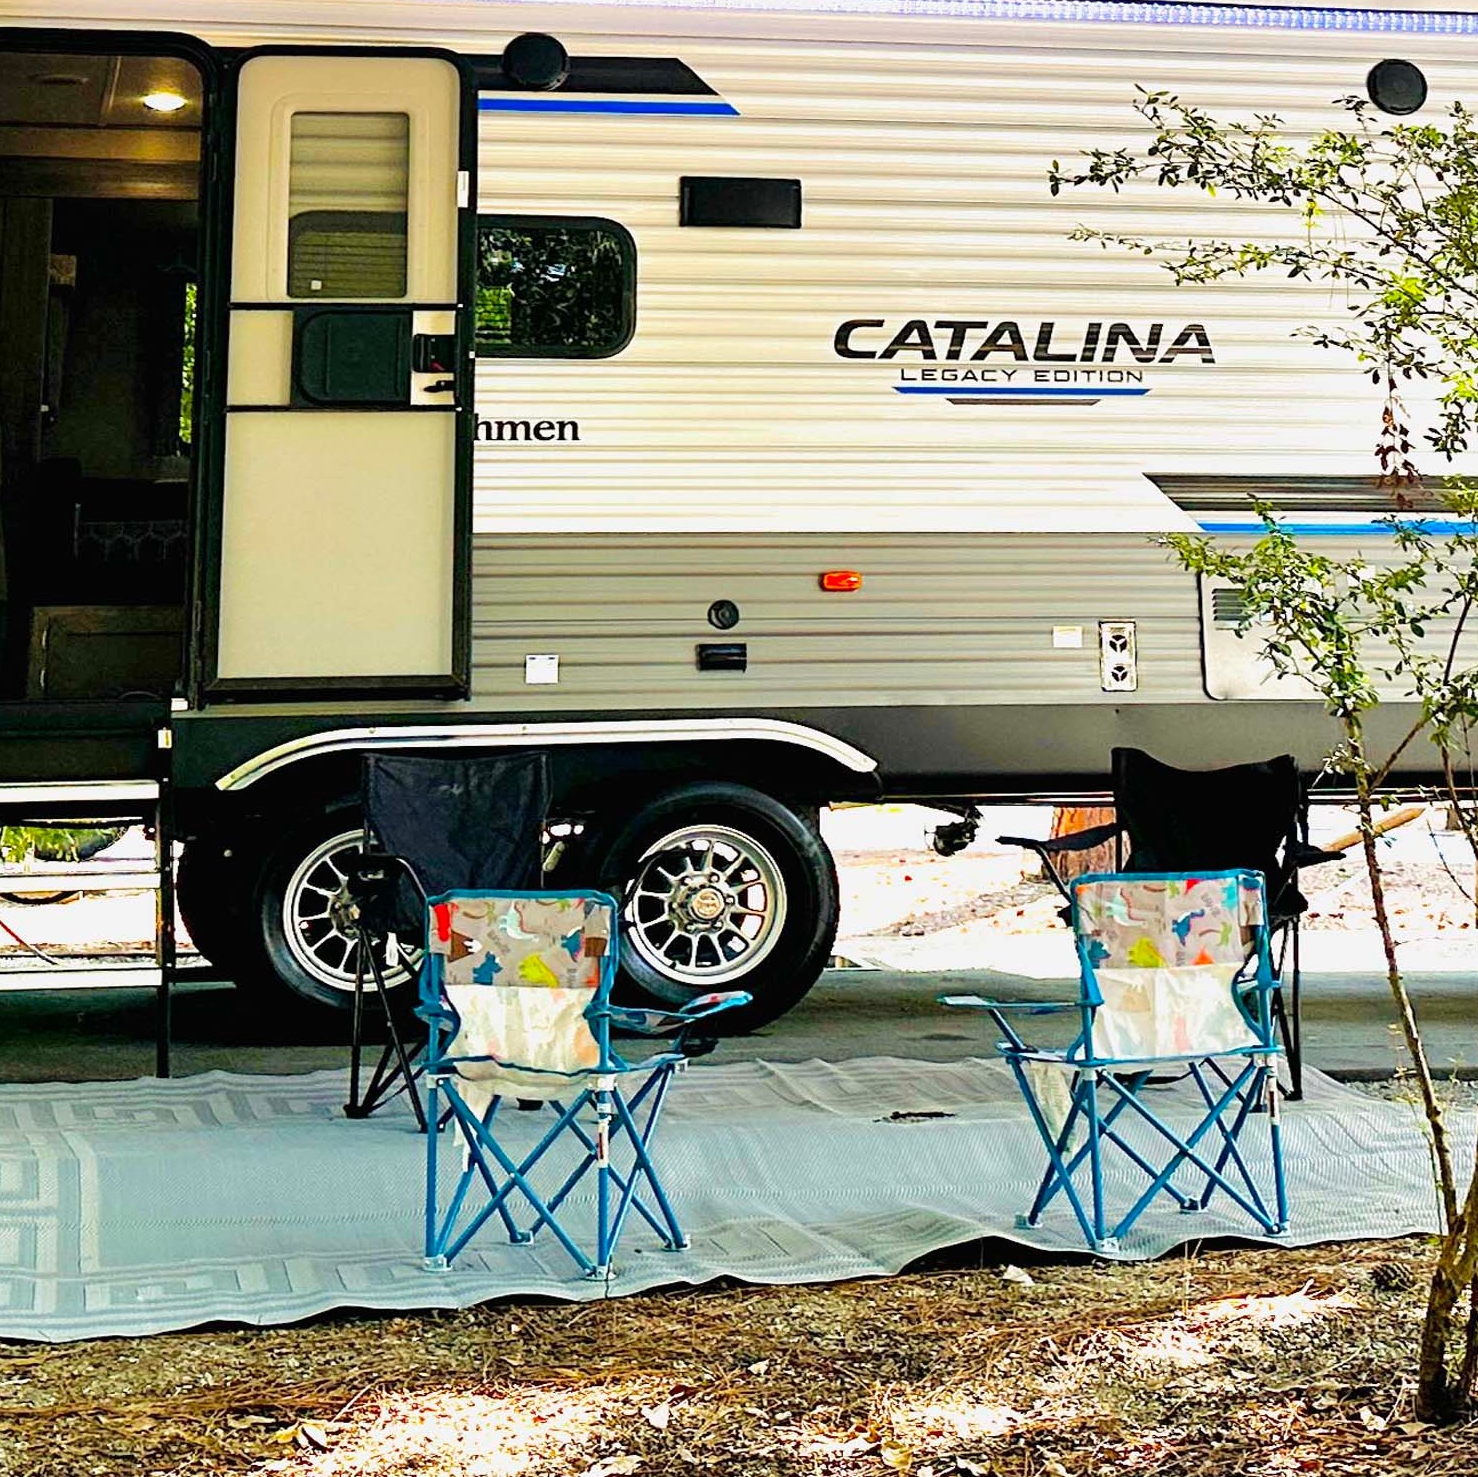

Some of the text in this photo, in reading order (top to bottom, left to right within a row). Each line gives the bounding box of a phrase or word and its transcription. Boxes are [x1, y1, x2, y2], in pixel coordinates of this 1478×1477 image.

[834, 319, 1216, 364] CATALINA
[900, 369, 1143, 383] LEGACY EDITION
